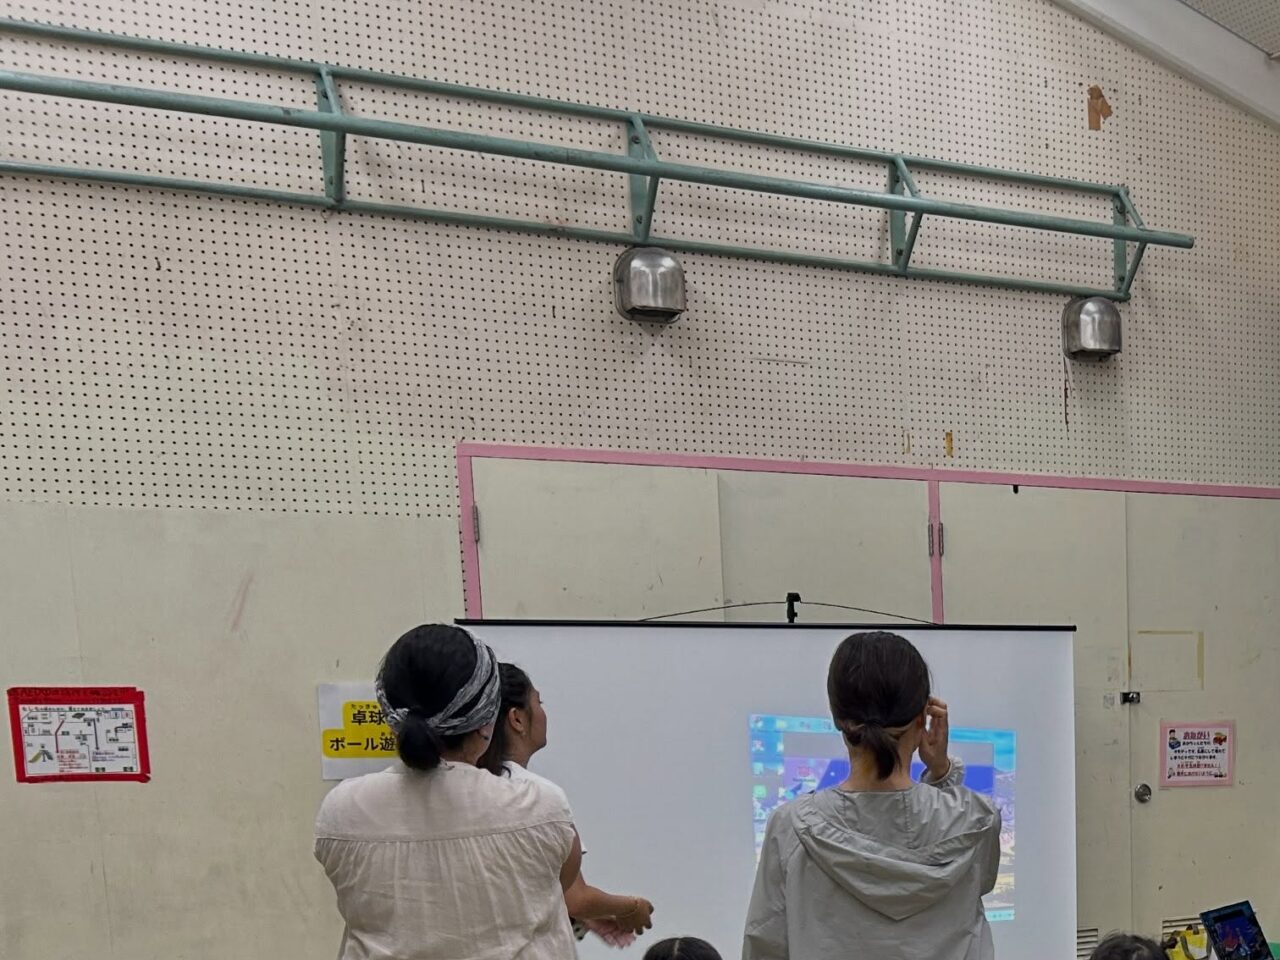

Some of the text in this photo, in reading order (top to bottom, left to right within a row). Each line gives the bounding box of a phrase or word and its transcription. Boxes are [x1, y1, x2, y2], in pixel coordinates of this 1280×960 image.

[351, 709, 386, 726] 卓球
[329, 737, 396, 752] ボール遊
